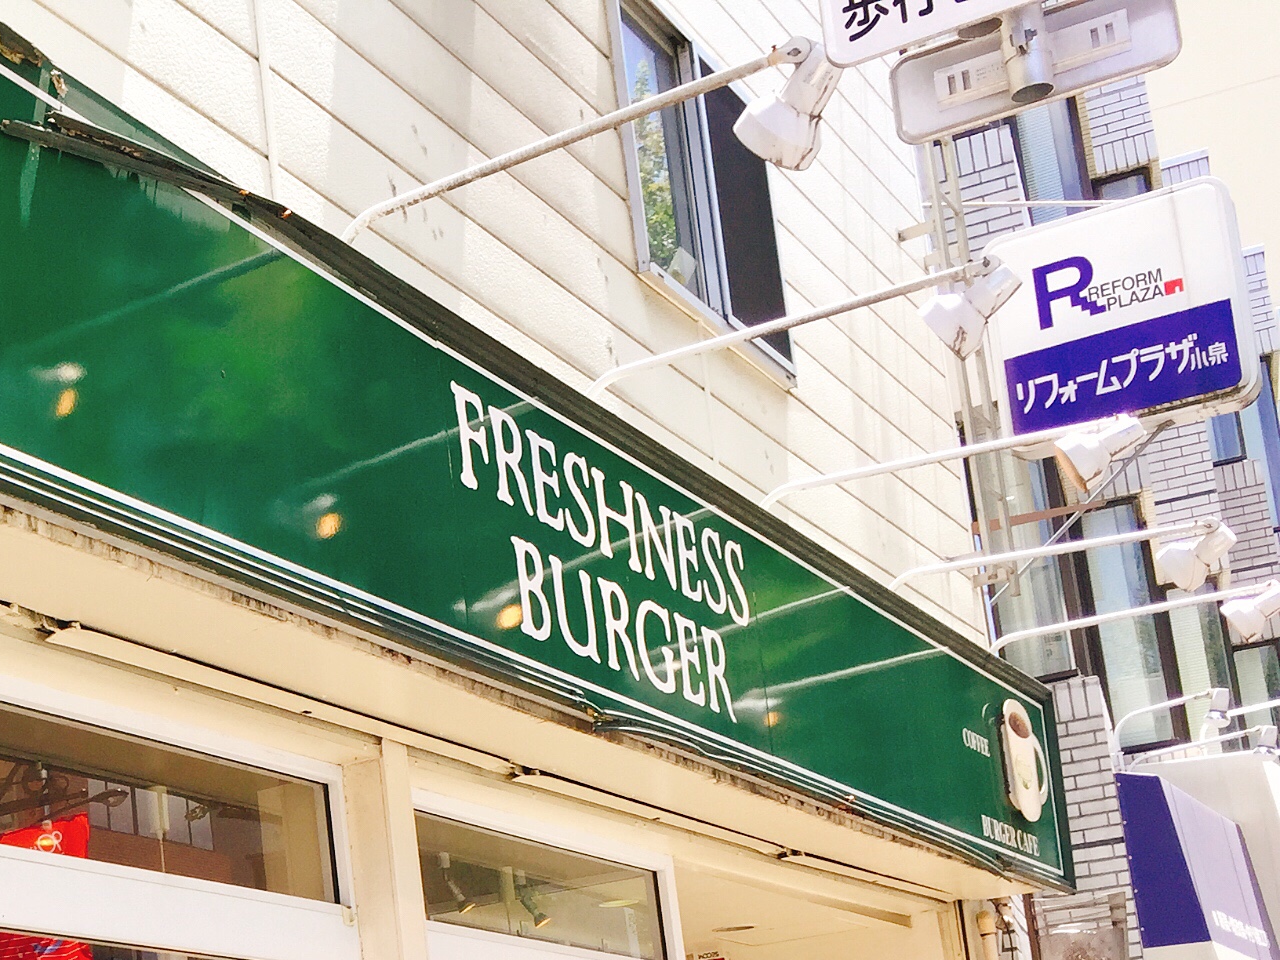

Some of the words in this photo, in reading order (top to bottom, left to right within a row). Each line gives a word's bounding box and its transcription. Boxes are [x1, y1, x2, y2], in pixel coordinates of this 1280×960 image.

[1087, 268, 1163, 302] REFORM
[1106, 285, 1164, 311] PLAZA
[450, 380, 749, 627] FRESHNESS
[510, 536, 738, 723] BURGER
[962, 728, 990, 757] COFFEE
[981, 814, 1017, 849] BURGER
[1016, 829, 1040, 857] CAFE
